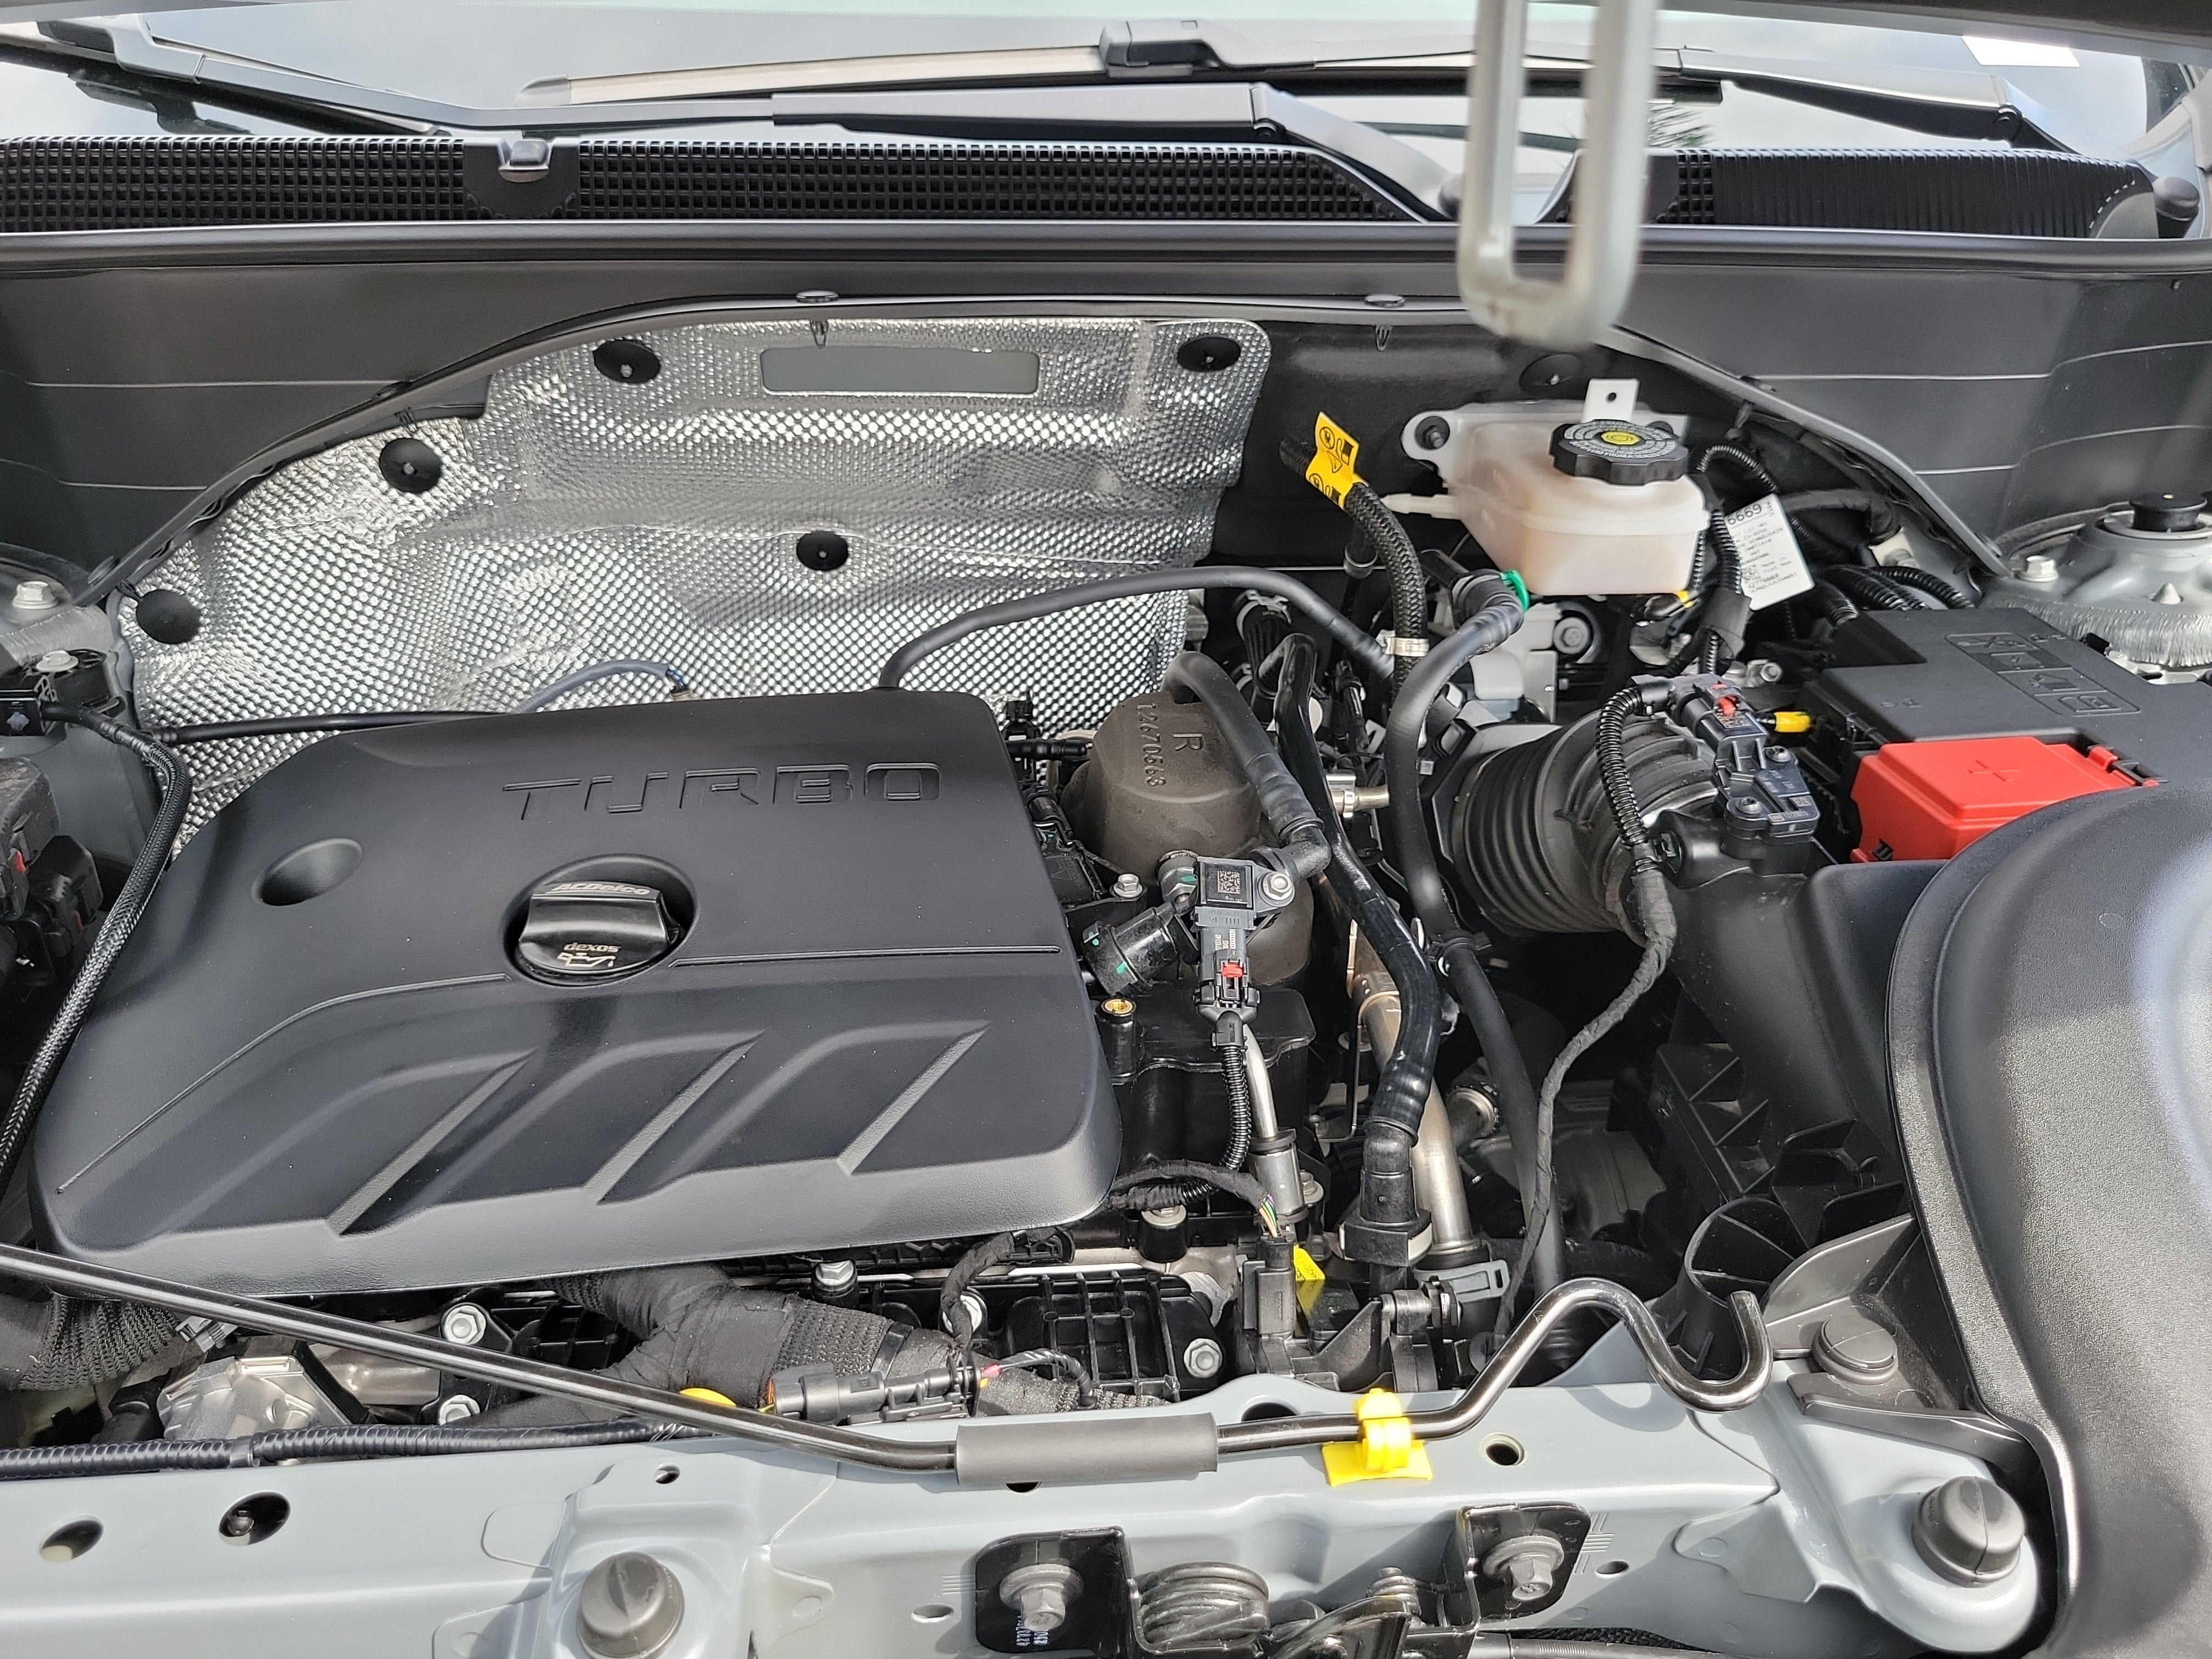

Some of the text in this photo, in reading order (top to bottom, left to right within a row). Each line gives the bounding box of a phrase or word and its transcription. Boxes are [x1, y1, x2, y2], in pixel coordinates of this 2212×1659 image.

[1173, 733, 1204, 752] R
[502, 761, 944, 821] TURBO
[550, 883, 651, 895] ACDelco
[563, 942, 622, 953] dexos
